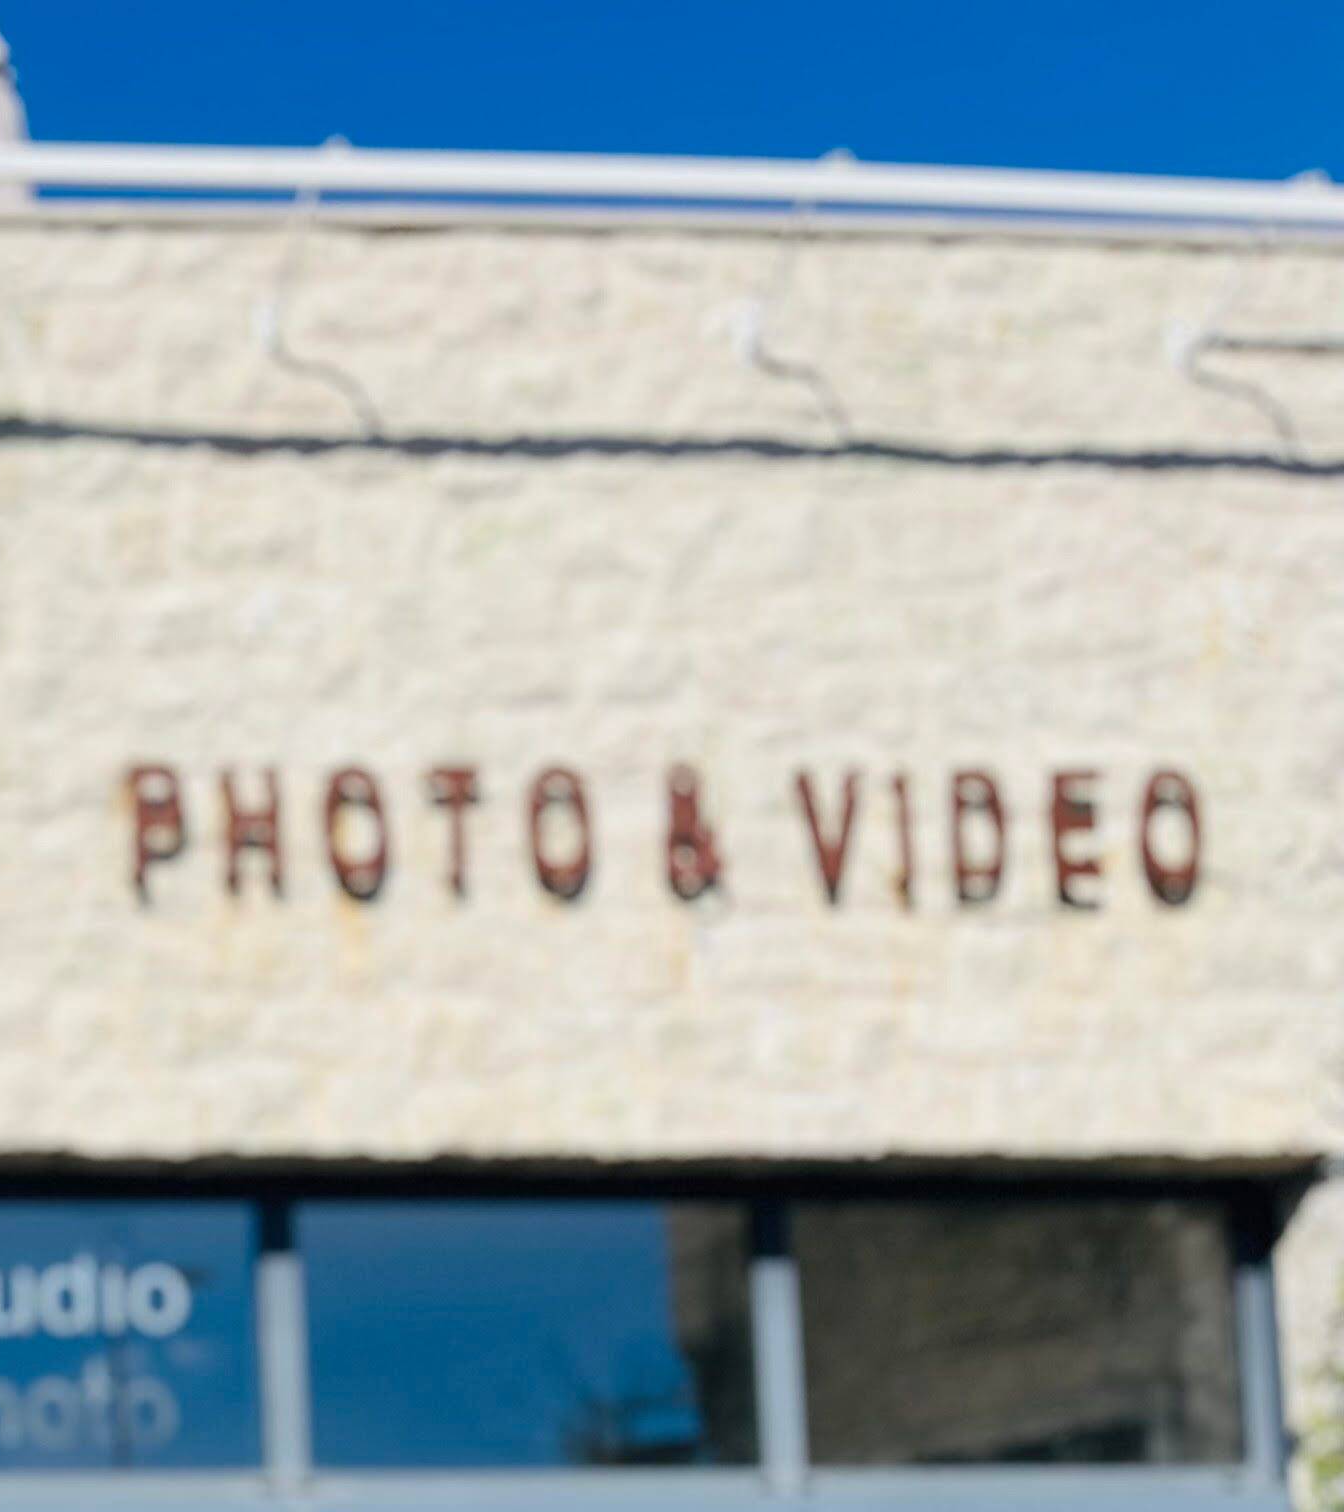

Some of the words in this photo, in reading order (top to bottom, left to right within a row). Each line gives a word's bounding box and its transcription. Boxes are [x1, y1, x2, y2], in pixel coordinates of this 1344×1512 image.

[124, 763, 594, 903] PHOTO
[664, 763, 720, 902] &
[794, 768, 1202, 906] VIDEO
